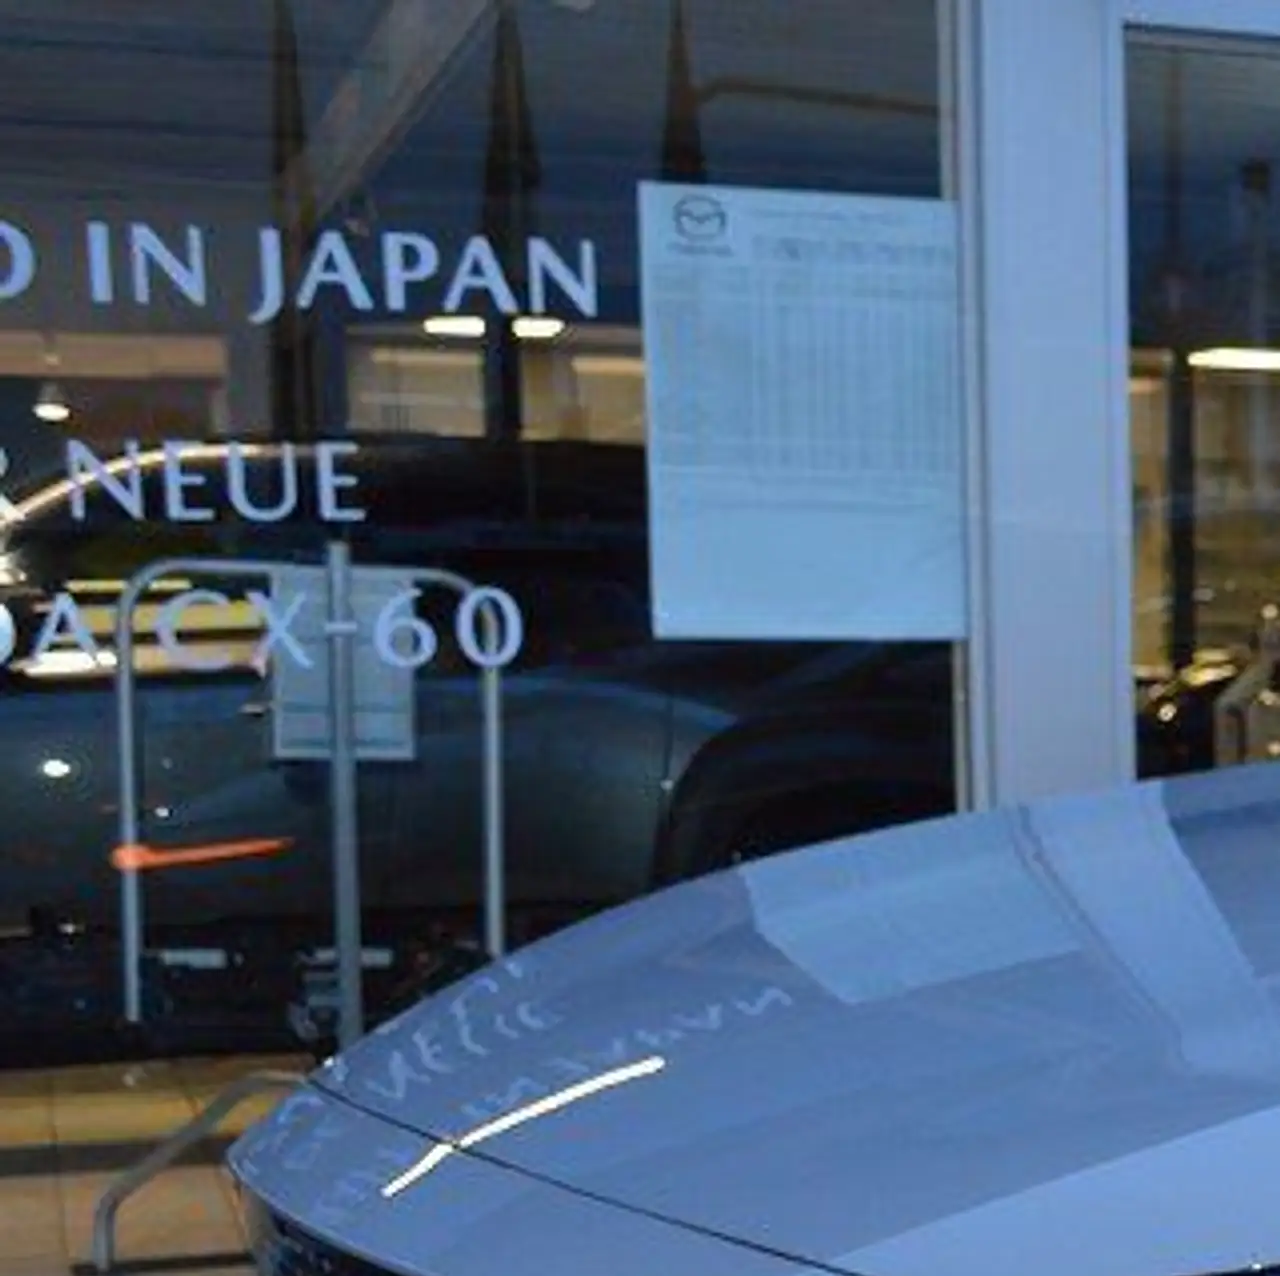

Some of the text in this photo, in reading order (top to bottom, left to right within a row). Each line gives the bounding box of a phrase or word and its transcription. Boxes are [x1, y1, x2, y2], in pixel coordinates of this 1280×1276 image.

[86, 219, 208, 307] IN
[249, 226, 600, 324] JAPAN
[64, 436, 367, 523] NEUE
[154, 583, 526, 671] CX-60
